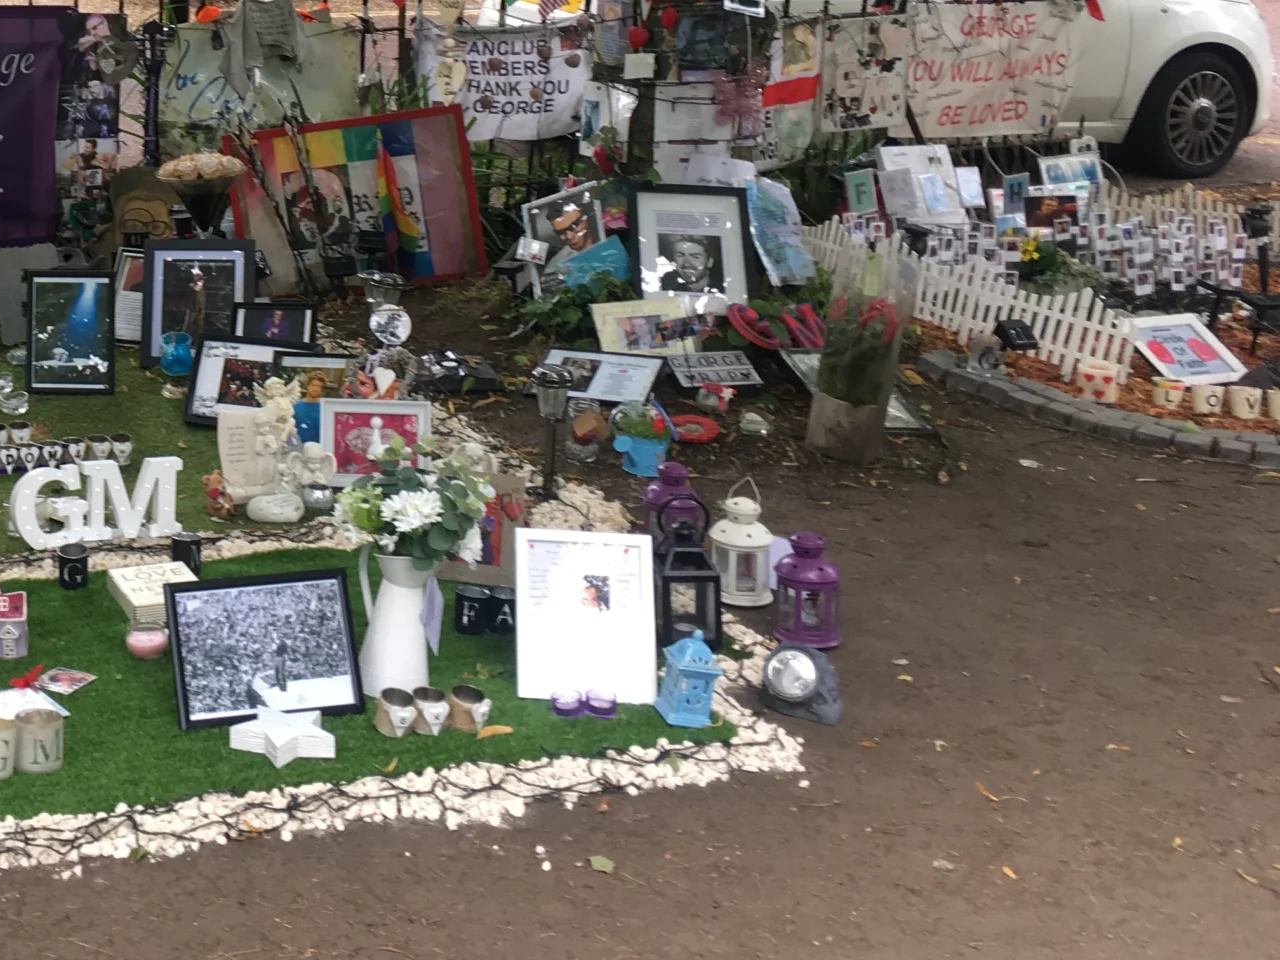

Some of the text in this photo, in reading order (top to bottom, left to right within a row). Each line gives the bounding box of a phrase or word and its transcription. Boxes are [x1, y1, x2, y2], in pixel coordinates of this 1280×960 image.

[950, 59, 994, 82] WILL
[466, 79, 522, 96] HANK
[937, 100, 1029, 126] BE LOVED
[670, 352, 750, 368] GEORGE
[10, 456, 184, 550] GM
[63, 563, 83, 584] G
[121, 567, 186, 582] LOVE
